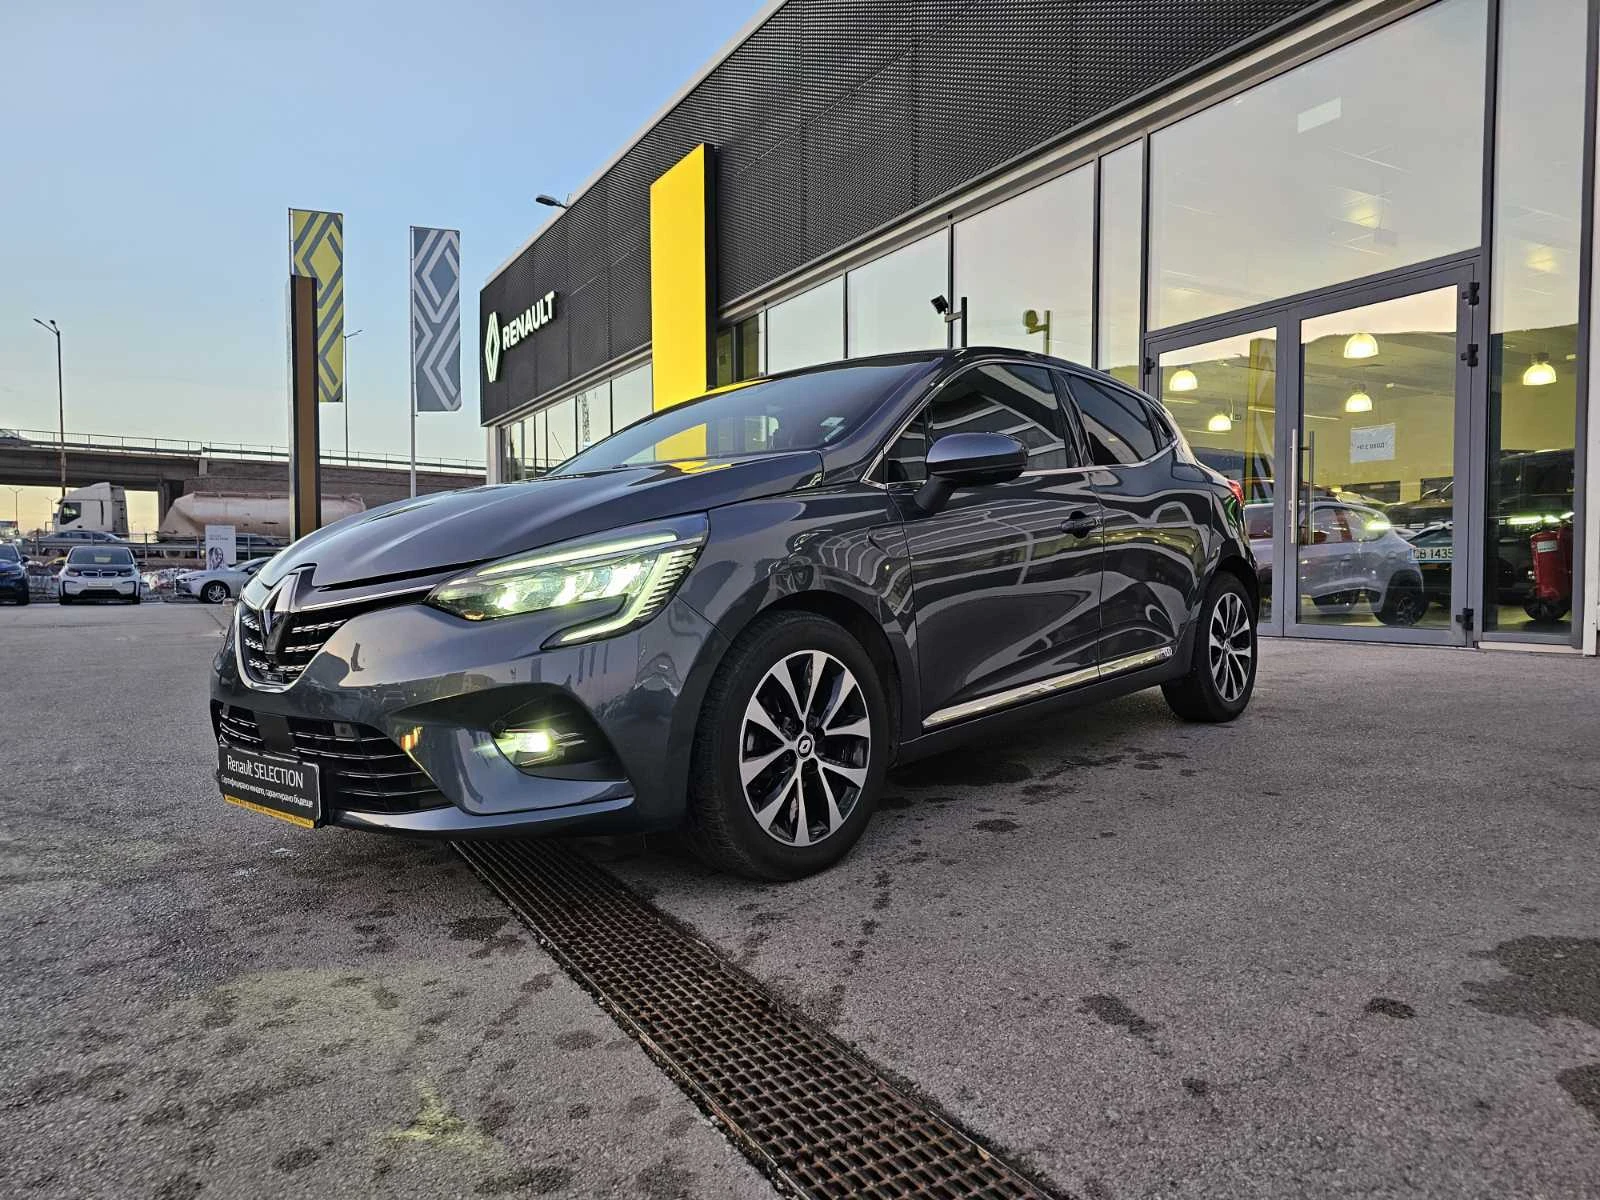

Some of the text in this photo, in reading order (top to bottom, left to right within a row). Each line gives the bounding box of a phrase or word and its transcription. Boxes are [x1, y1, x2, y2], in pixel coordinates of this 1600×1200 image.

[502, 290, 555, 351] RENAULT
[227, 754, 304, 789] Renault SELECTION
